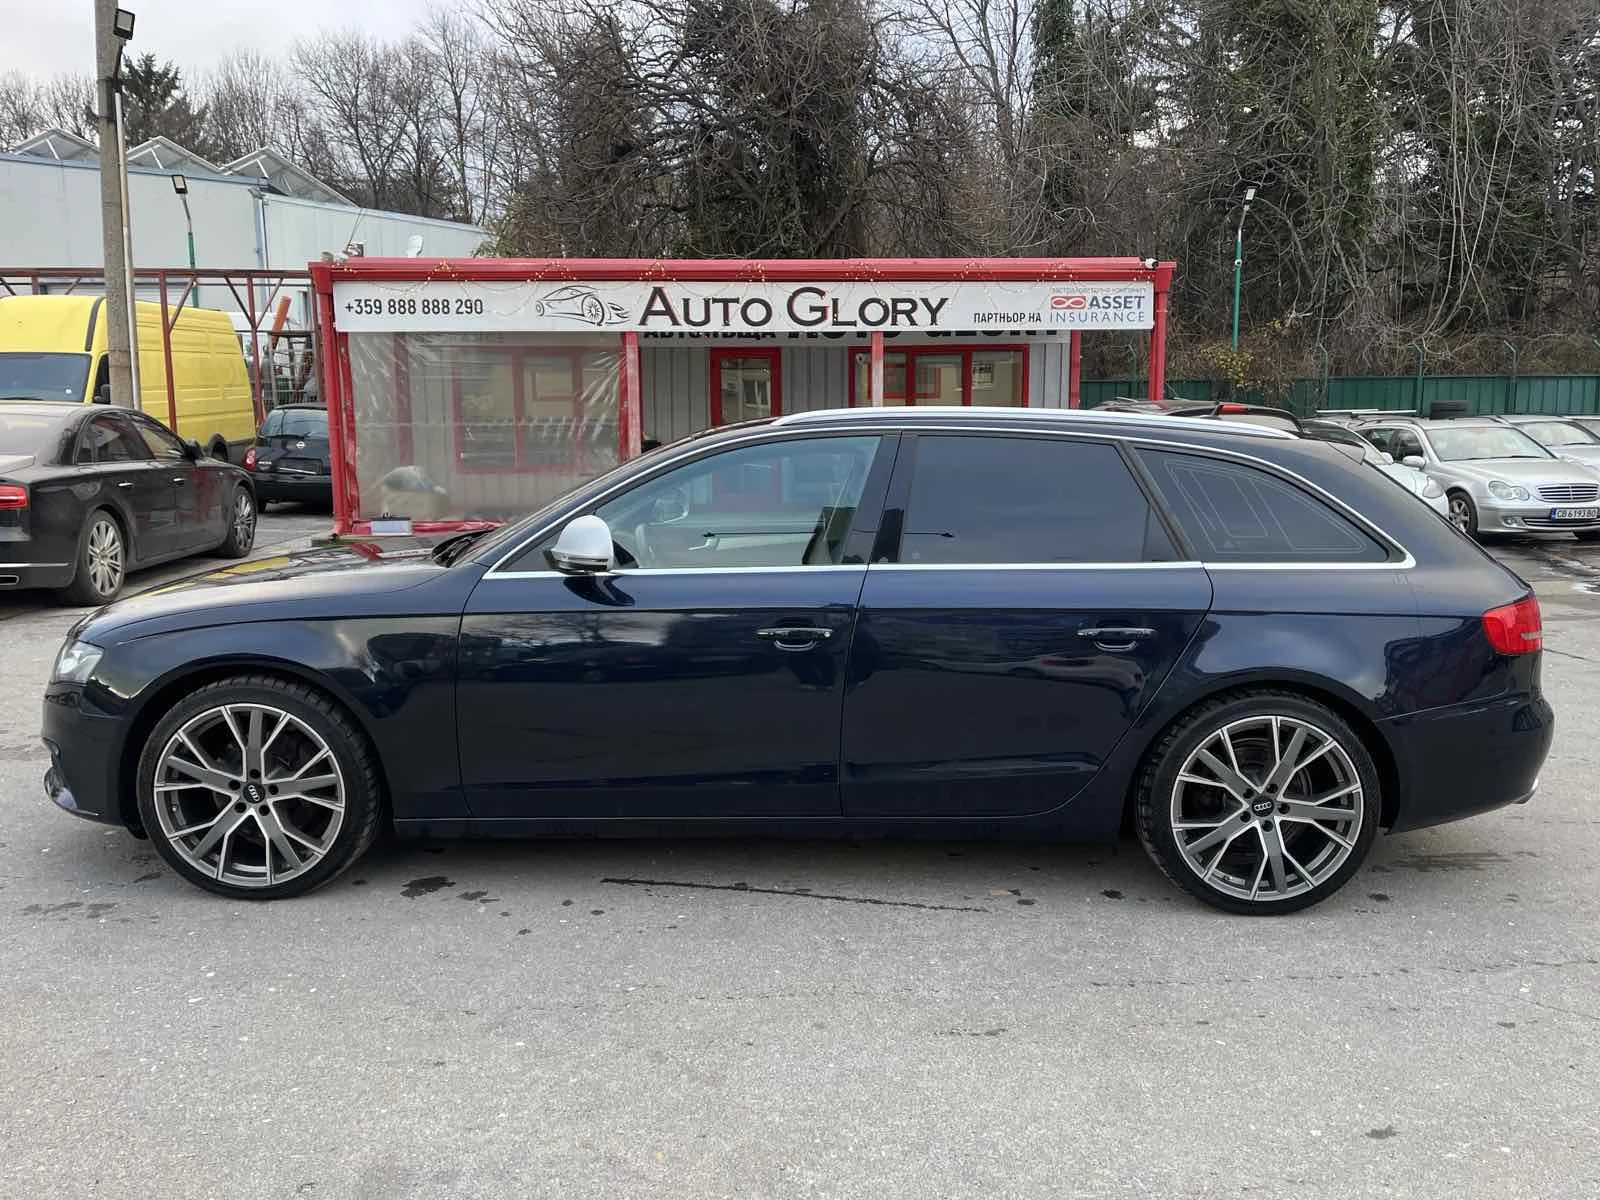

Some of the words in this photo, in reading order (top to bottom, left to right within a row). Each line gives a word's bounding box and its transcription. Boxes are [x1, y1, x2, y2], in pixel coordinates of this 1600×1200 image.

[345, 298, 382, 315] +359
[387, 298, 417, 315] 888
[421, 298, 451, 315] 888
[455, 298, 483, 315] 290
[638, 286, 773, 327] AUTO
[786, 286, 949, 327] GLORY
[1089, 295, 1145, 310] ASSET
[973, 312, 1026, 324] ПАРТНЬОР
[1028, 312, 1042, 324] НА
[1050, 311, 1145, 323] INSURANCE
